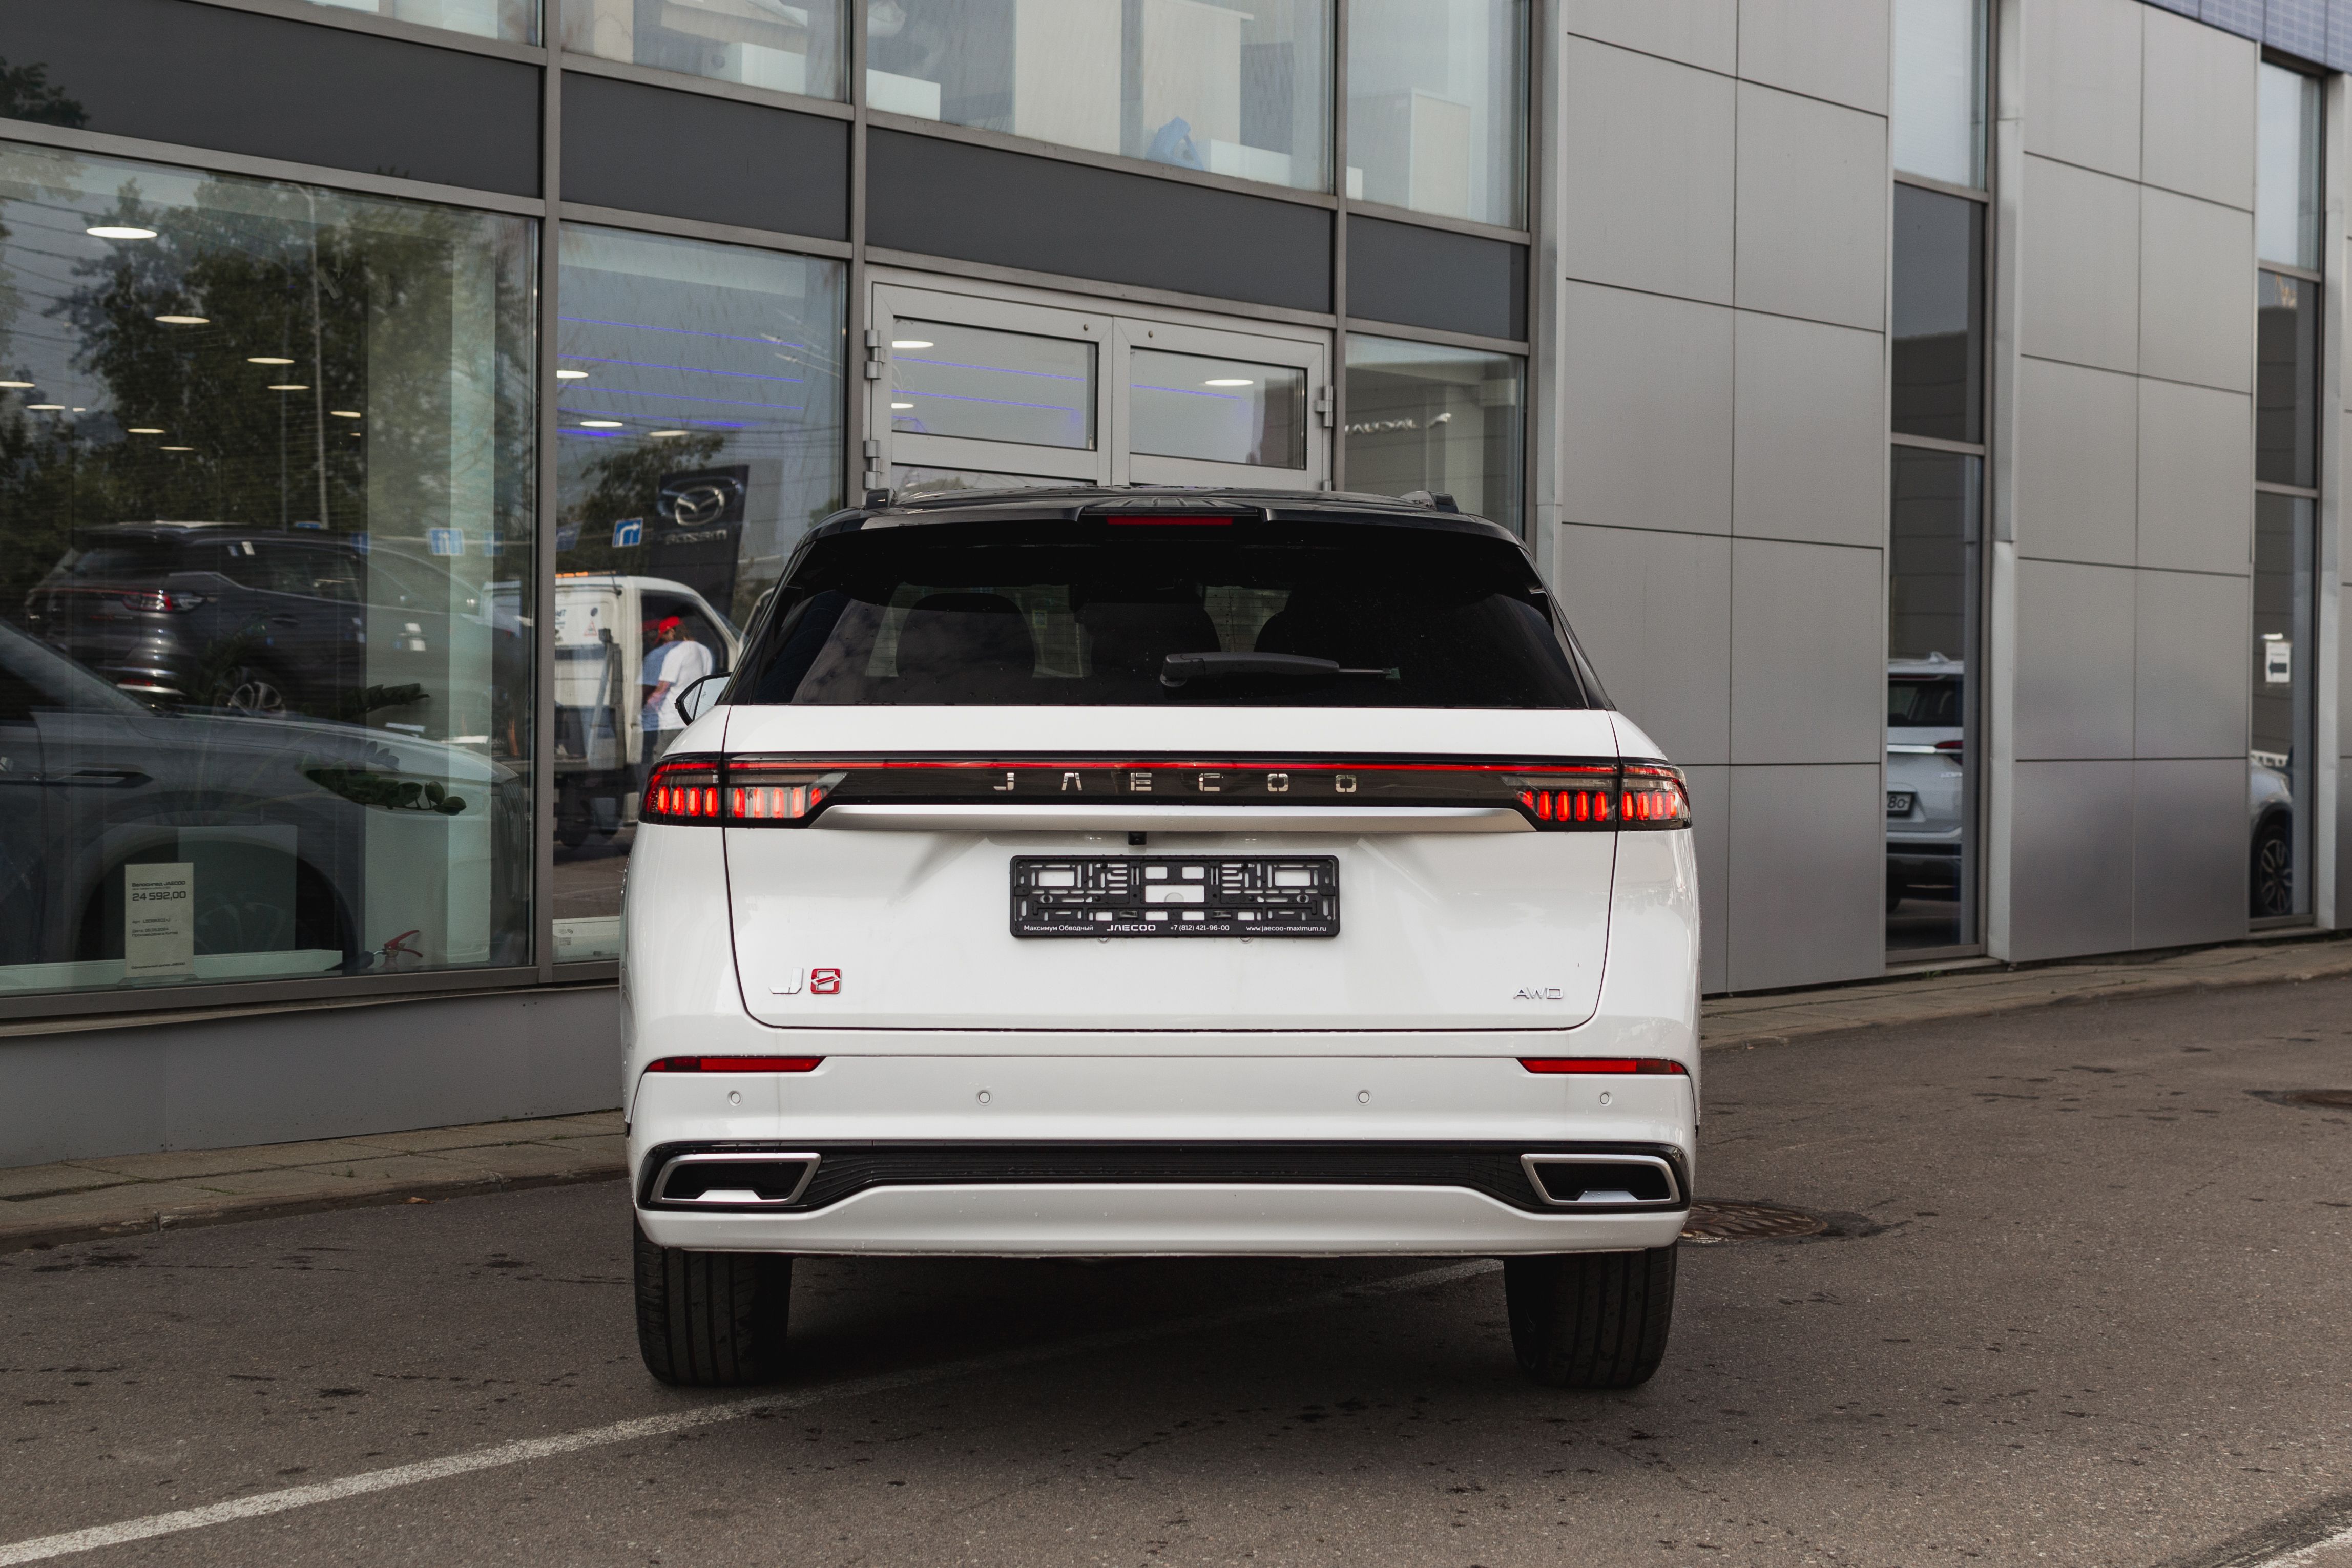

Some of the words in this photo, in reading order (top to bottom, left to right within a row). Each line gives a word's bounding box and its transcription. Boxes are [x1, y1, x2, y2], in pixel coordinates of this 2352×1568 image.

[993, 772, 1357, 792] JAECOO
[132, 893, 147, 901] 24
[149, 891, 186, 901] 592,00
[1512, 985, 1564, 999] AWD
